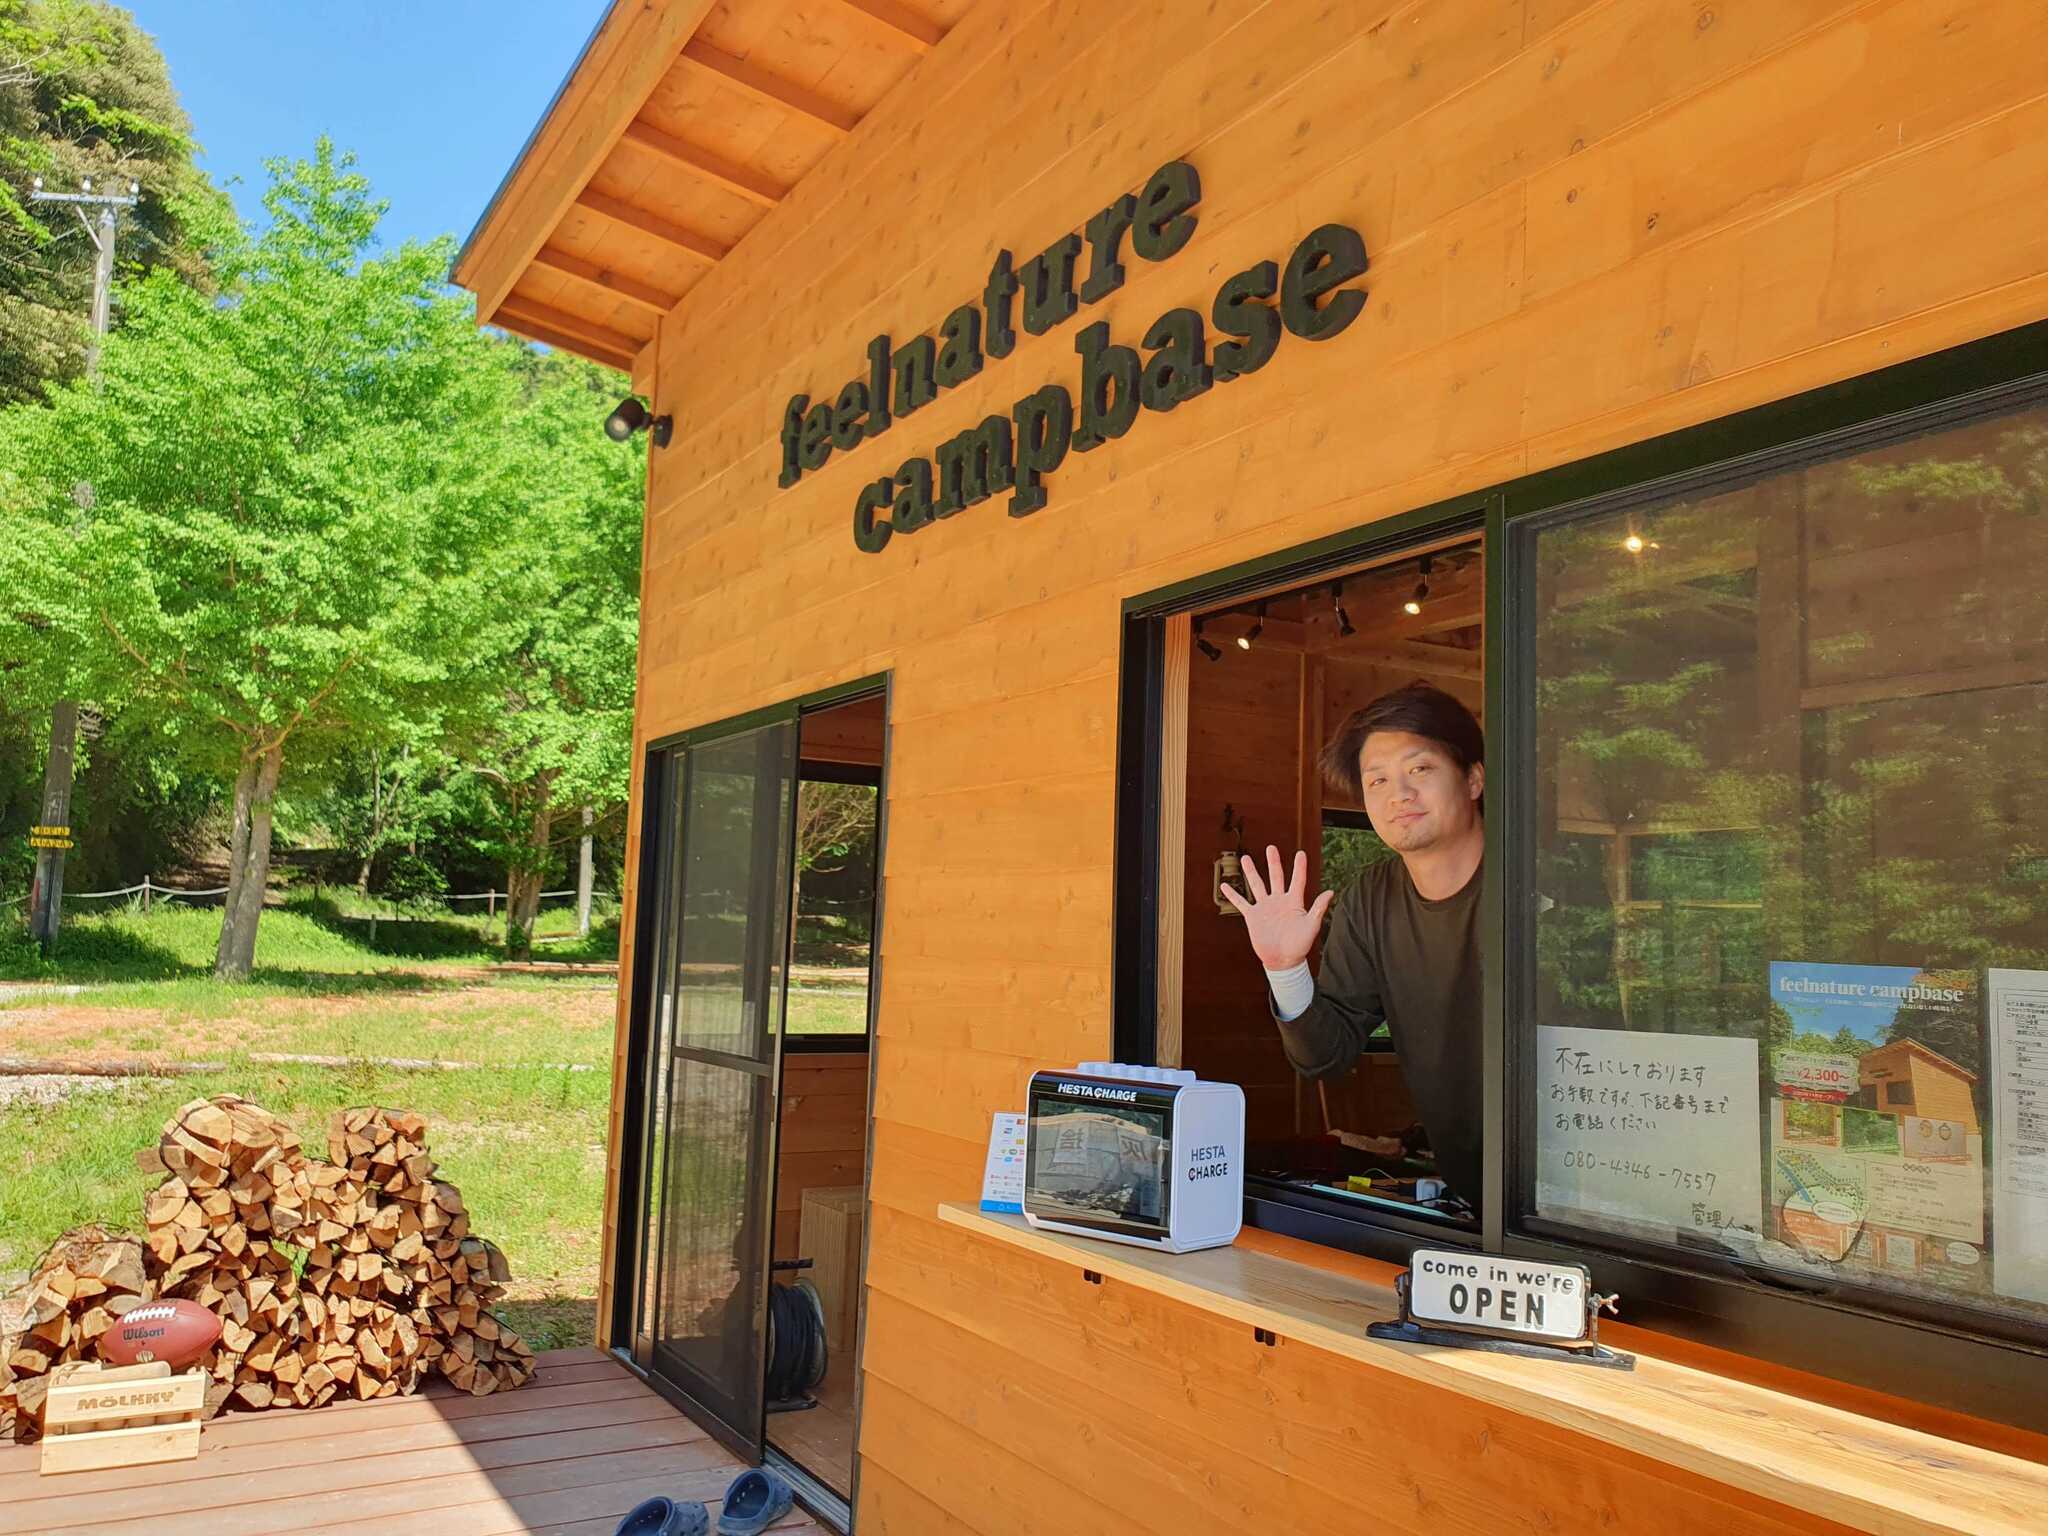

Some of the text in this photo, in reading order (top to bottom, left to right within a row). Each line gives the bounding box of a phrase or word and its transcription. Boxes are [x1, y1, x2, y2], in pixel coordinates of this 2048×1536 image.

[778, 160, 1201, 489] feelnature
[853, 223, 1369, 553] campbase
[1780, 976, 1965, 1003] feelnature campbase
[1555, 1047, 1707, 1088] 不在にしております
[1555, 1112, 1657, 1132] お電話ください
[1191, 1145, 1225, 1162] HESTA
[1188, 1163, 1228, 1181] CHARGE
[1423, 1260, 1575, 1291] come in we're
[1449, 1283, 1545, 1330] OPEN
[122, 1327, 165, 1341] Wilson
